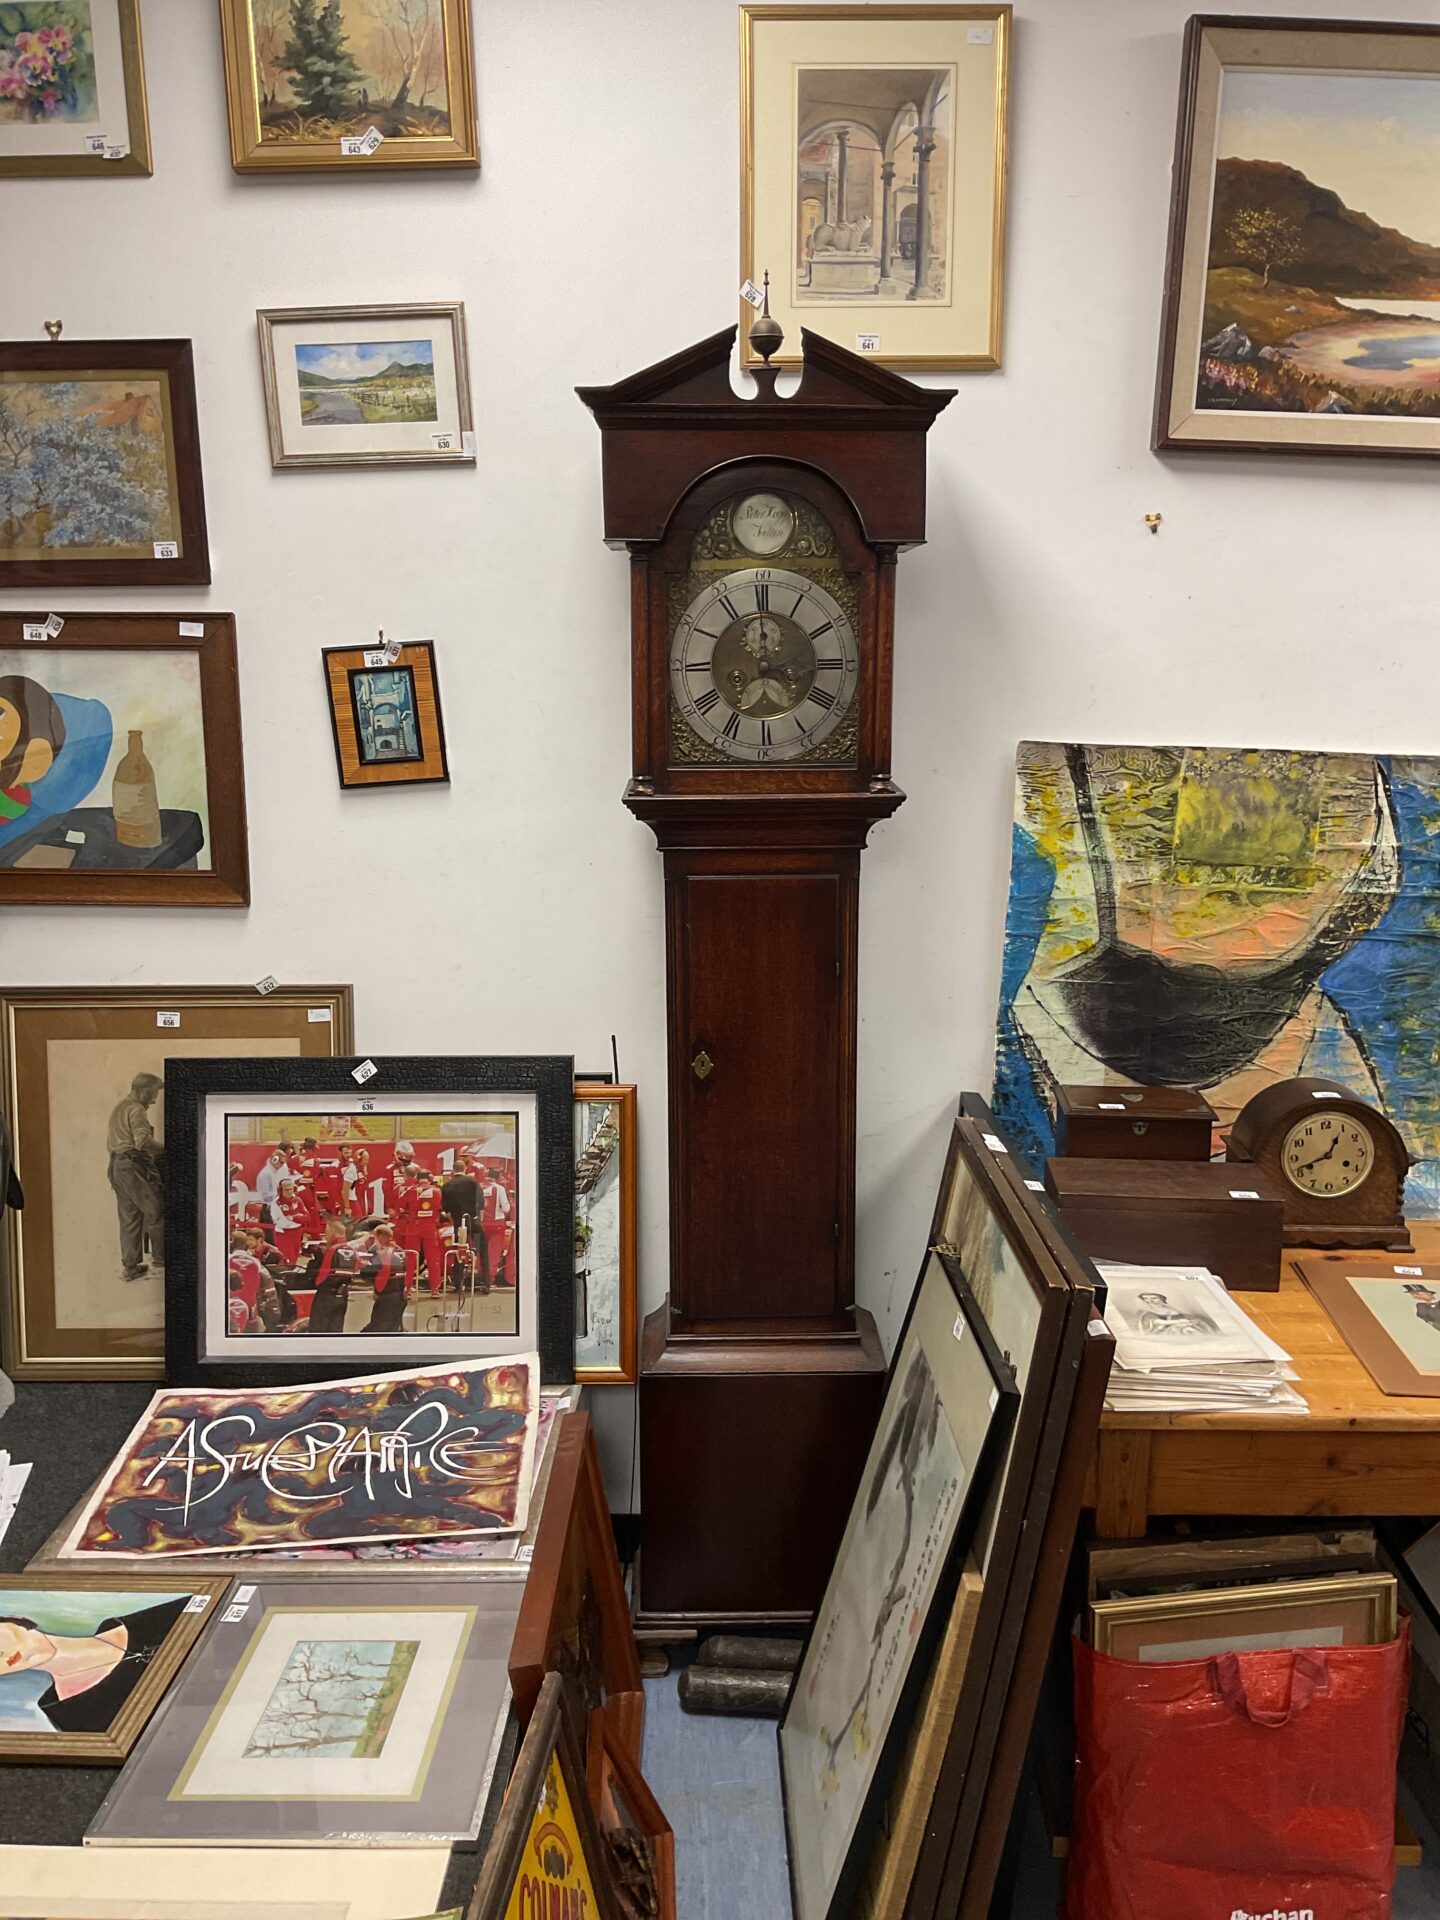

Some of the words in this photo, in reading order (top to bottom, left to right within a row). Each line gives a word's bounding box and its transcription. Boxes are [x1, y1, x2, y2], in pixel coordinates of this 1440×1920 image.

[92, 142, 105, 150] 646
[368, 136, 380, 150] 629
[745, 290, 757, 303] 628
[862, 342, 874, 350] 641
[437, 440, 450, 449] 630
[160, 549, 173, 557] 633
[755, 569, 771, 581] 60
[30, 631, 42, 639] 648
[391, 646, 400, 657] 631
[370, 658, 383, 666] 645
[263, 982, 275, 992] 612
[360, 1068, 372, 1080] 627
[361, 1103, 374, 1111] 636
[1320, 1120, 1332, 1130] 12
[1304, 1127, 1313, 1136] 11
[1351, 1133, 1359, 1142] 2
[1294, 1138, 1305, 1148] 10
[1357, 1147, 1365, 1158] 3
[1290, 1154, 1299, 1164] 9
[1296, 1167, 1304, 1178] 8
[1309, 1179, 1317, 1188] 7
[1342, 1176, 1350, 1186] 5
[1324, 1182, 1333, 1192] 6
[232, 1609, 245, 1618] 617
